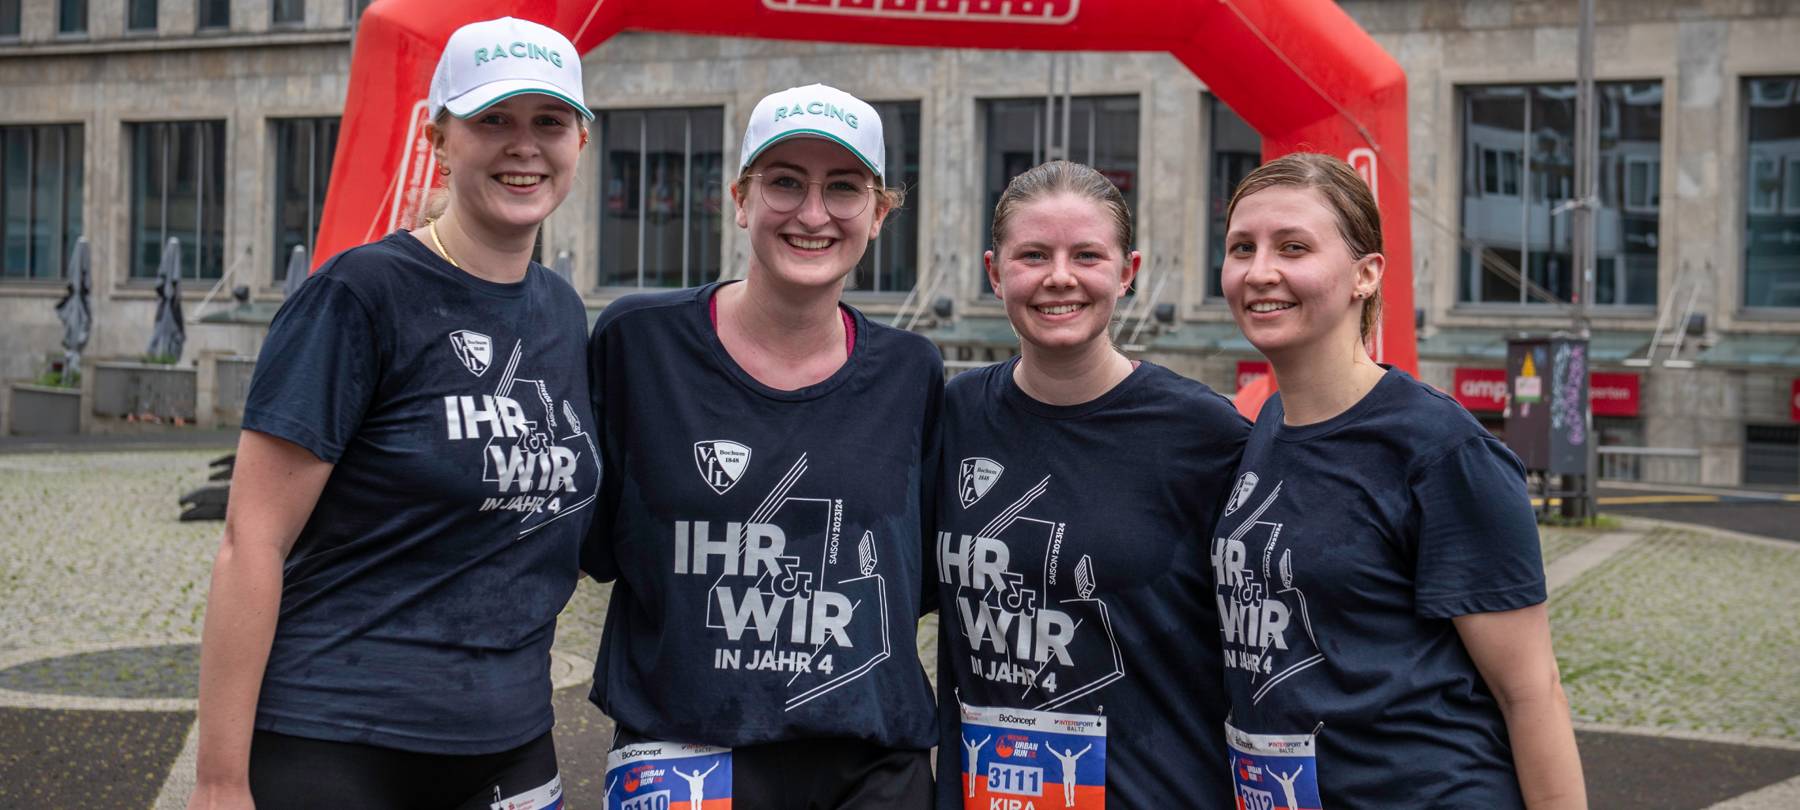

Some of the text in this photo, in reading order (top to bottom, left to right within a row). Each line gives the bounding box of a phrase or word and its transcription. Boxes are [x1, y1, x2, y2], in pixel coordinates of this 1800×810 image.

[475, 42, 562, 68] RACING
[774, 101, 858, 129] RACING
[444, 394, 530, 440] IHR
[488, 445, 577, 492] WIR
[479, 495, 561, 514] IN JAHR 4
[674, 520, 786, 577] IHR
[829, 533, 840, 565] SAISON
[1211, 537, 1245, 587] HR
[771, 556, 813, 600] &
[1049, 555, 1058, 586] SAISON
[998, 572, 1036, 618] &
[716, 586, 853, 648] WIR
[958, 596, 1075, 667] WIR
[1216, 594, 1289, 650] WIR
[714, 648, 834, 675] IN JAHR 4
[984, 660, 1038, 689] JAHR
[1041, 671, 1058, 694] 4
[1263, 655, 1273, 675] 4
[999, 713, 1036, 726] BoConcept
[621, 748, 662, 760] BoConcept
[1013, 749, 1028, 758] RUN
[1015, 741, 1039, 751] URBAN
[988, 767, 1039, 793] 3111
[1242, 788, 1273, 810] 3112
